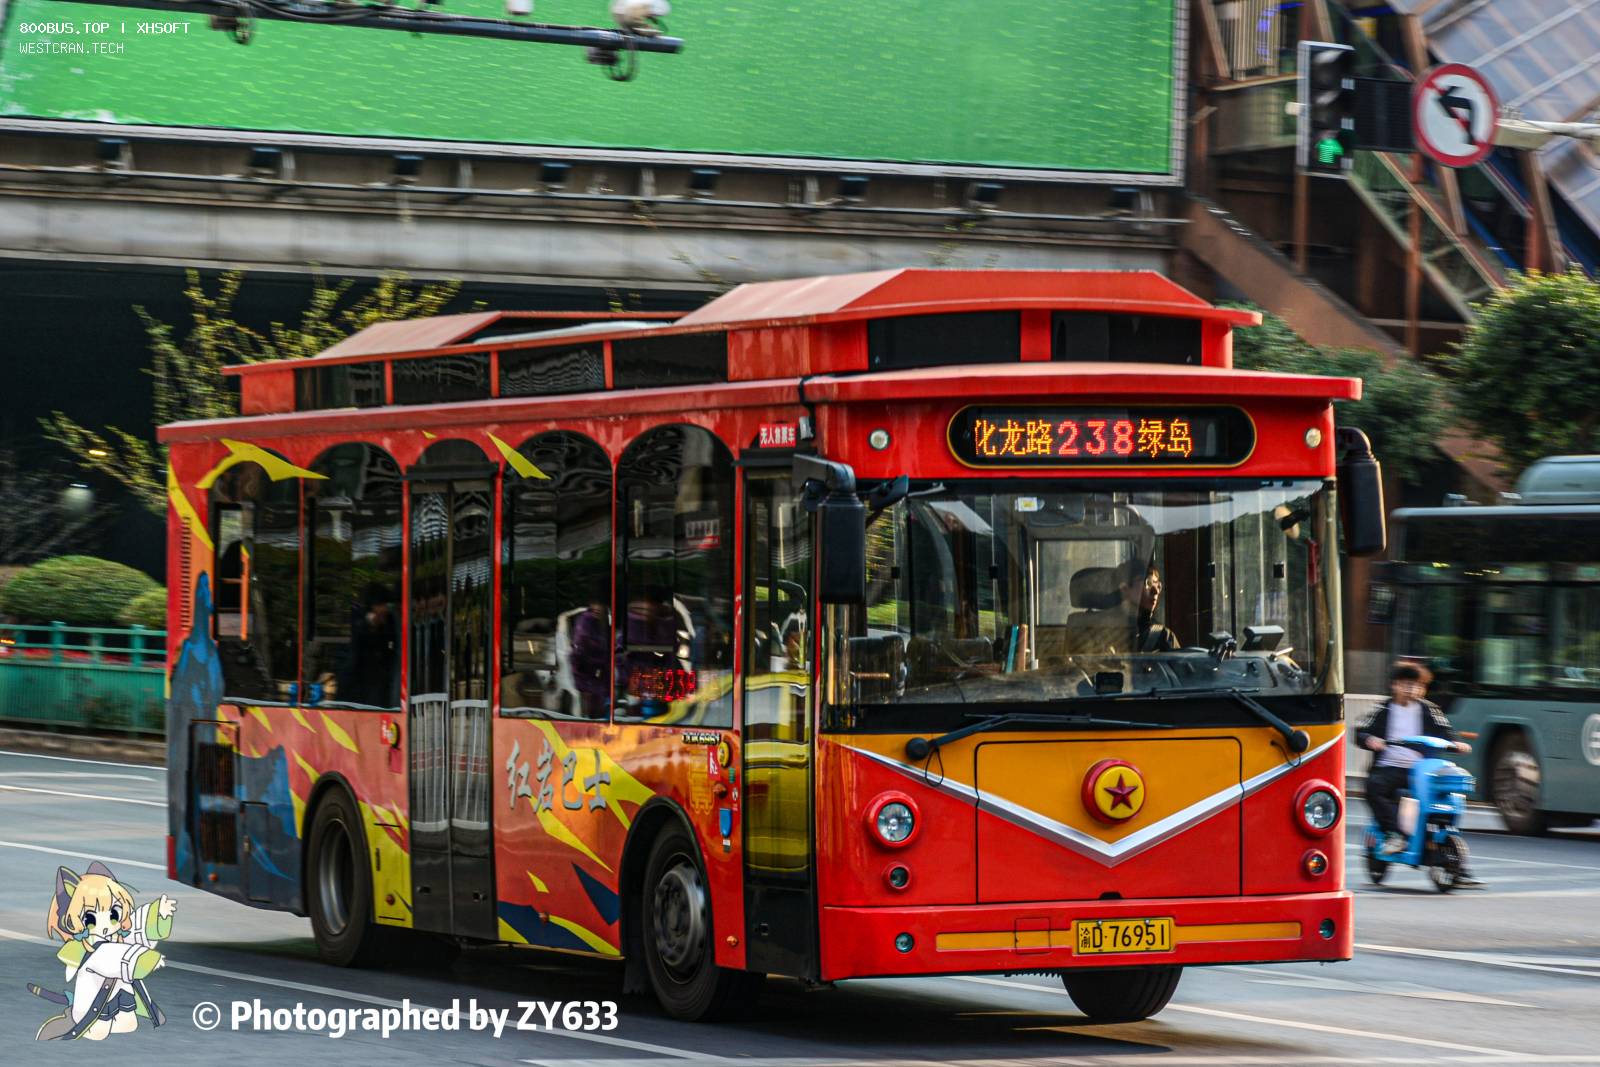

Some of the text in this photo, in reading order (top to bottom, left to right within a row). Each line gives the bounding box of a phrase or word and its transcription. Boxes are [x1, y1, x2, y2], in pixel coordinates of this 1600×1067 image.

[974, 418, 1193, 458] 化龙路 238 绿岛
